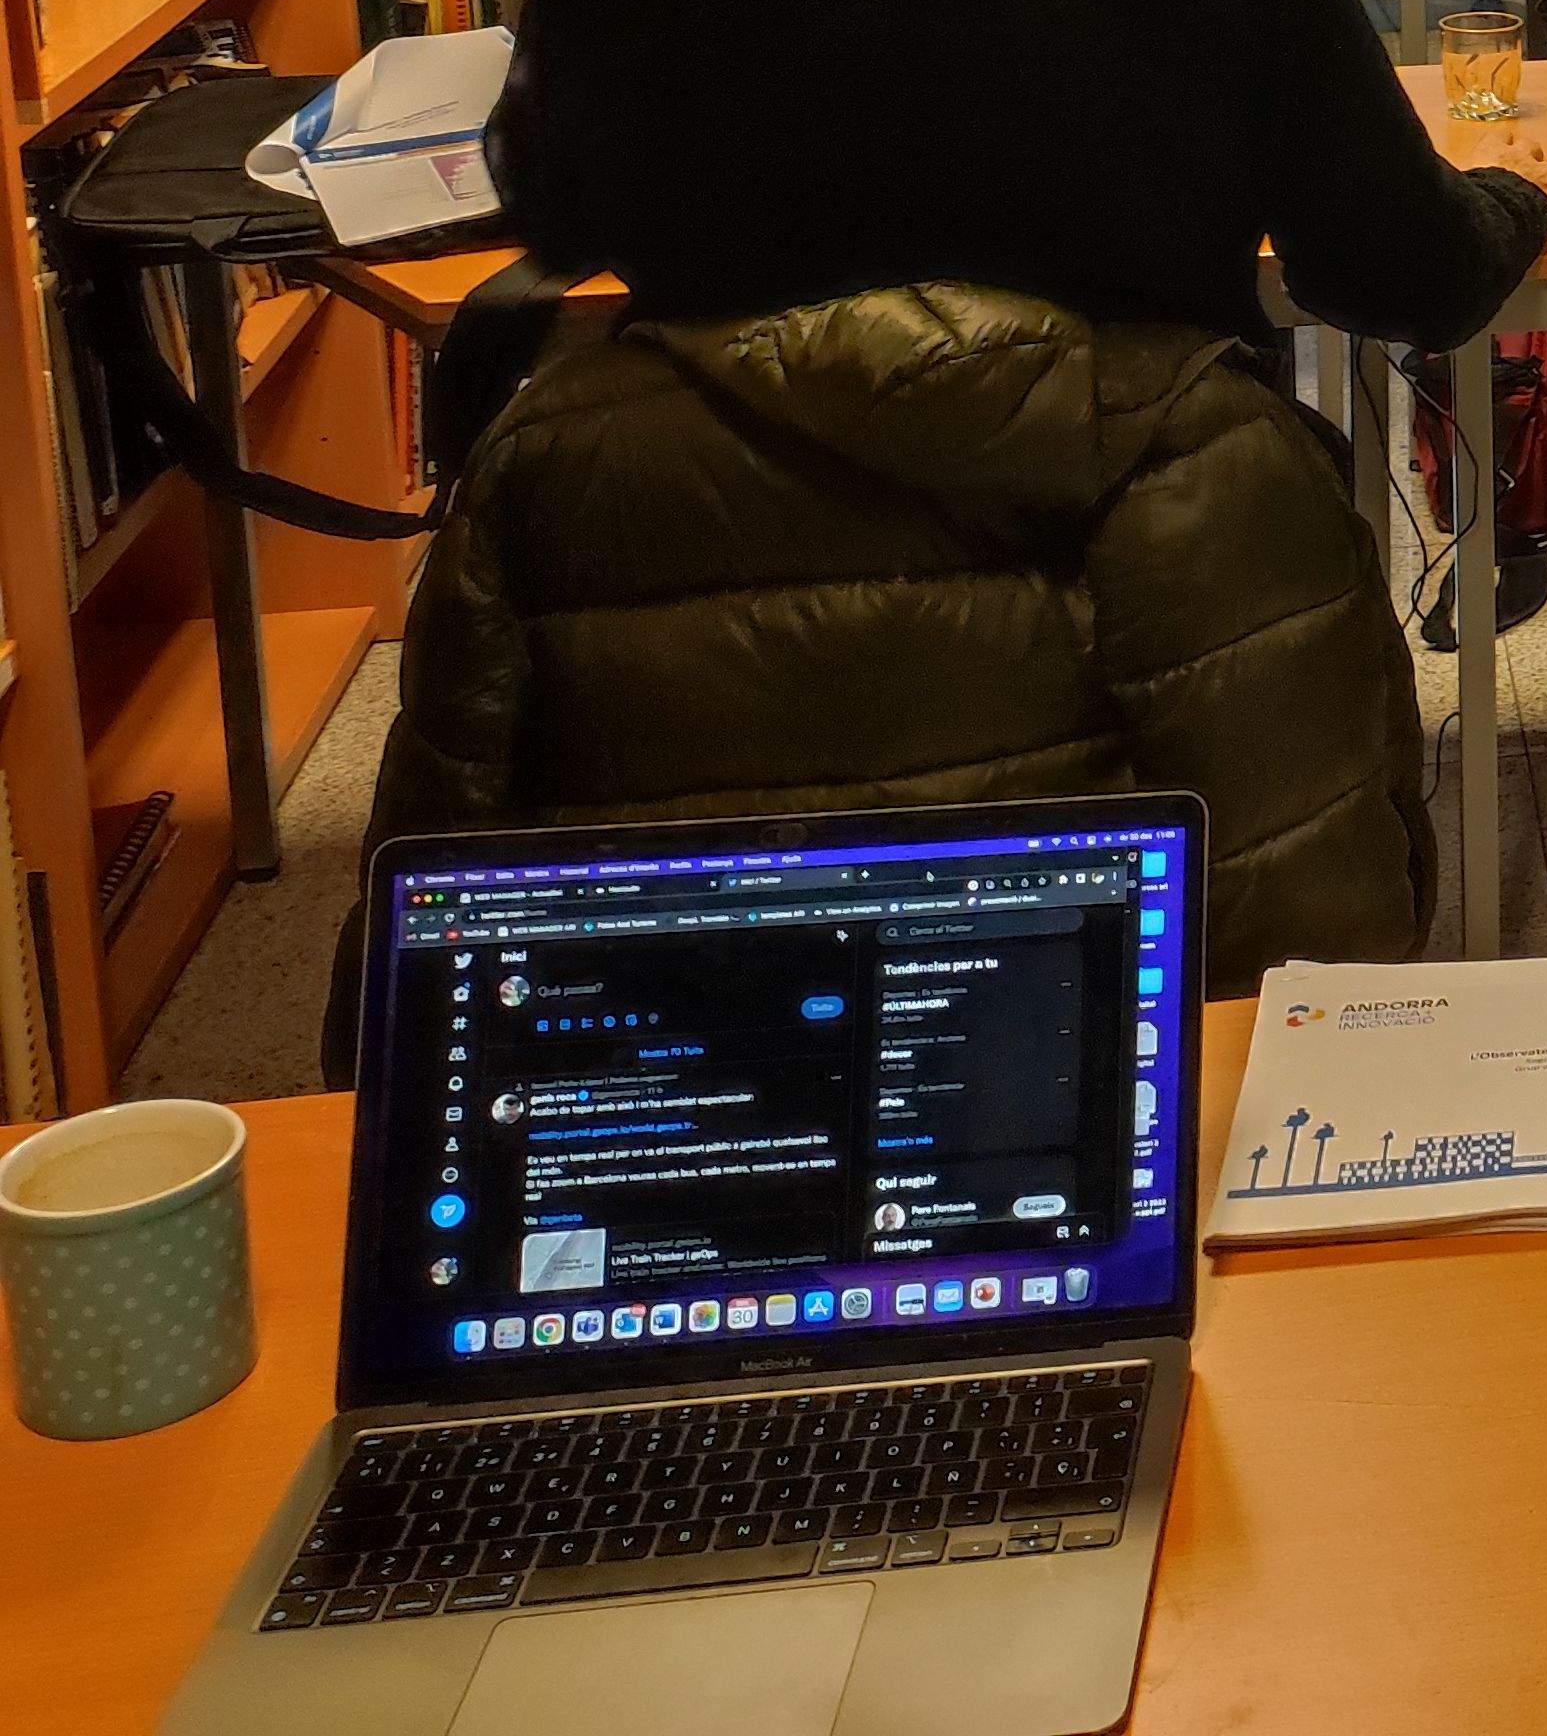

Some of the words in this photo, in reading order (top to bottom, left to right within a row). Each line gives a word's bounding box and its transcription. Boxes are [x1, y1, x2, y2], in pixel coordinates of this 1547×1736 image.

[1342, 998, 1449, 1013] ANDORRA
[732, 1309, 754, 1326] 30
[740, 1357, 795, 1372] MacBook
